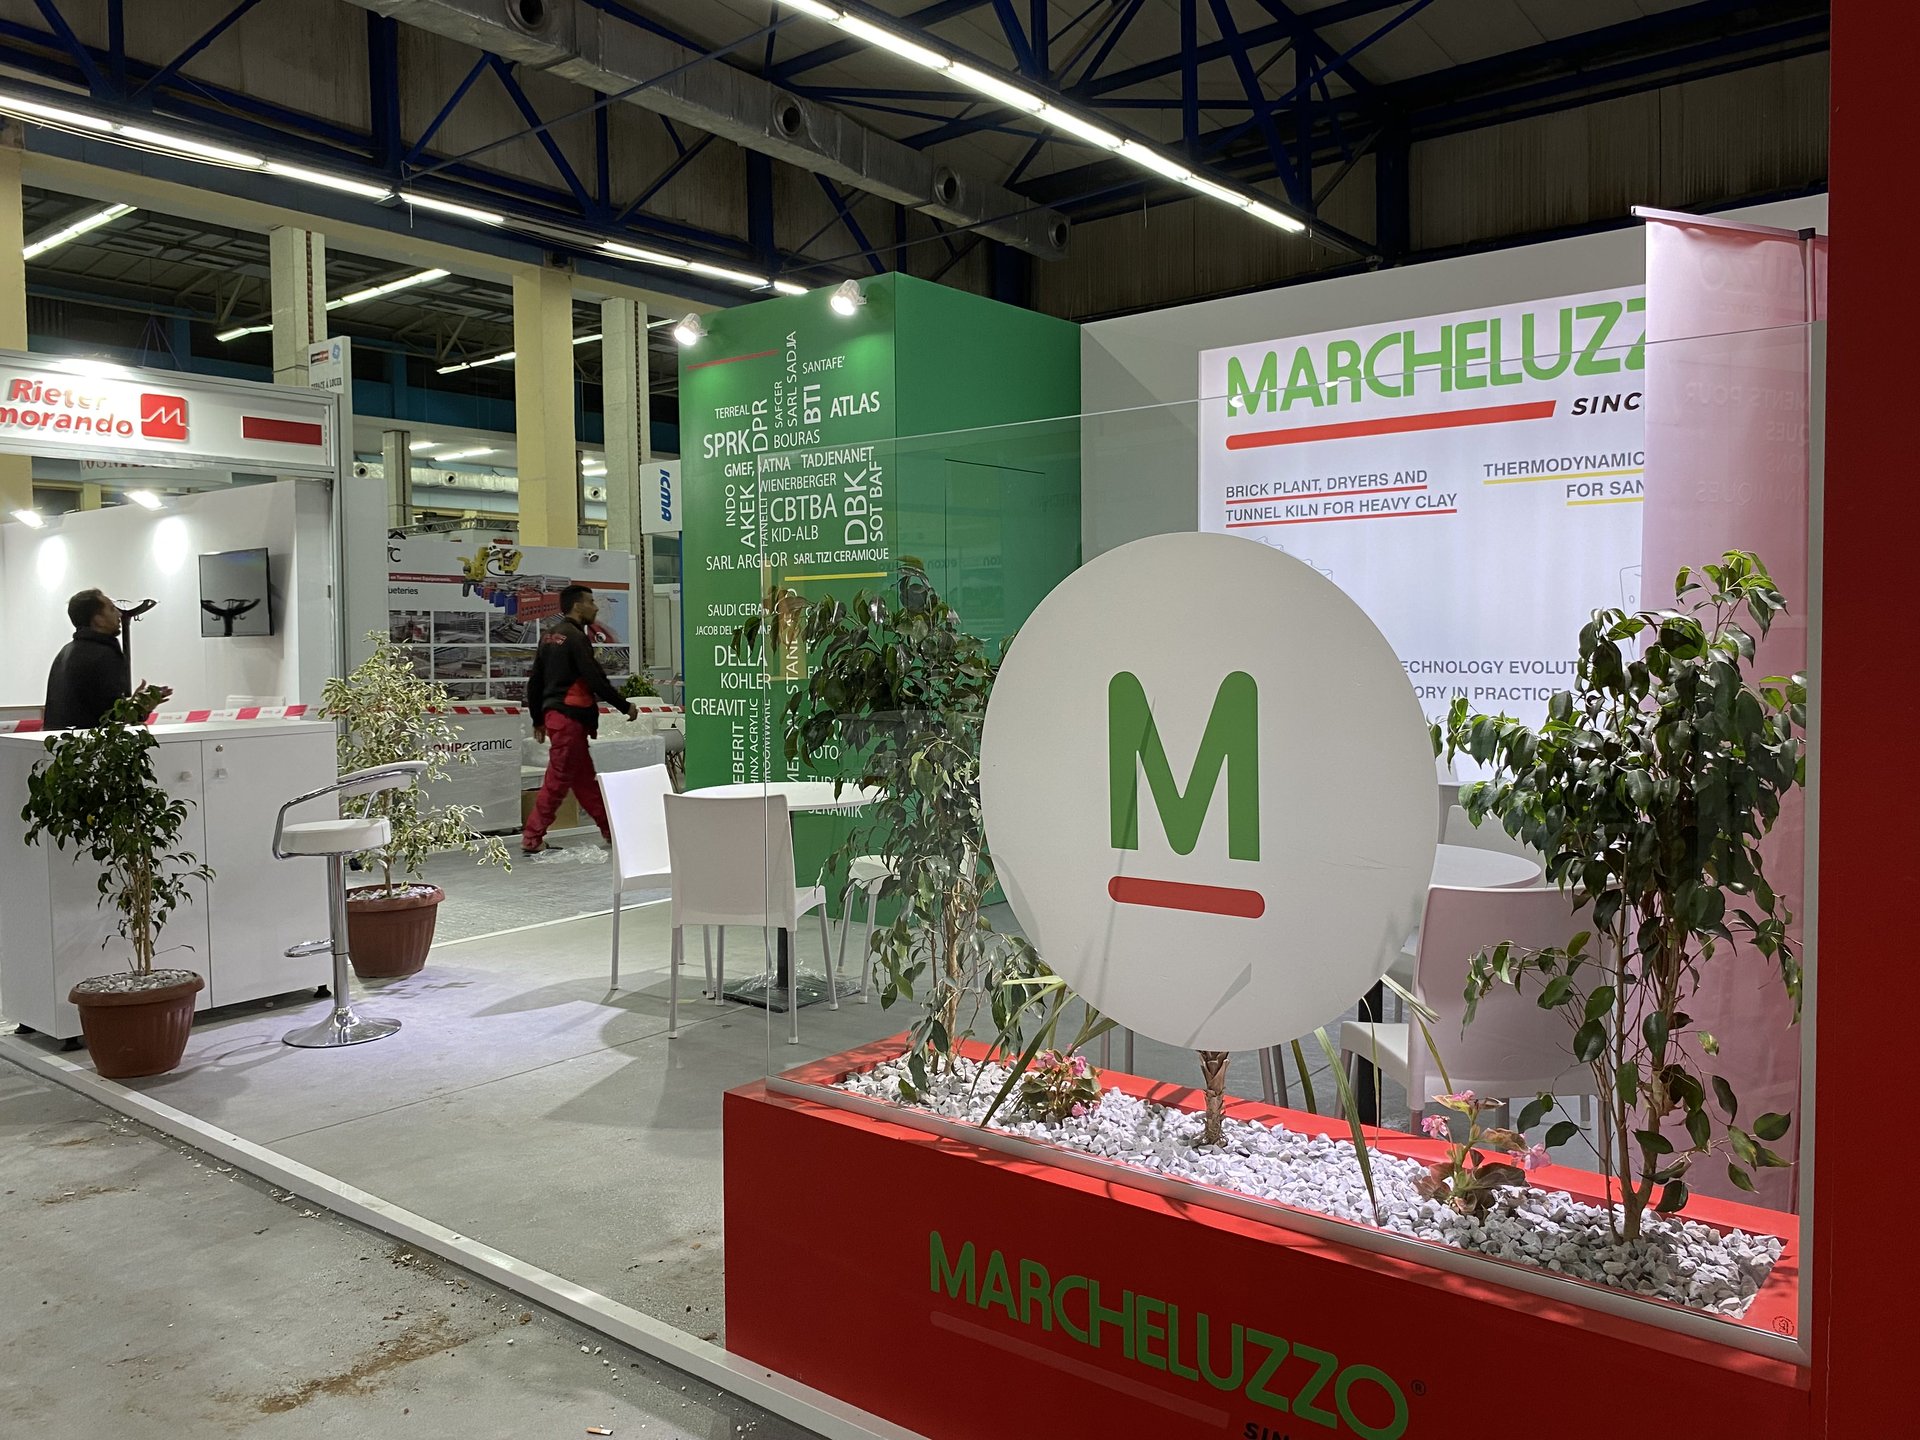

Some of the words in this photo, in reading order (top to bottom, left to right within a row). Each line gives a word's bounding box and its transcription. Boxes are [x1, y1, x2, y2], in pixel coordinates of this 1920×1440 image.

[714, 404, 750, 419] TERREAL
[774, 380, 783, 428] SAFCER
[787, 386, 798, 427] SARL
[803, 384, 821, 424] BTI
[830, 391, 880, 418] ATLAS
[0, 407, 134, 437] morando
[752, 398, 768, 452] DPR
[703, 428, 751, 459] SPRK
[774, 429, 820, 449] BOURAS
[801, 446, 875, 469] TADJENANET
[1484, 451, 1645, 478] THERMODYNAMIC
[759, 472, 837, 493] WIENERBERGER
[868, 461, 883, 499] BAF
[1226, 483, 1269, 499] BRICK
[1273, 479, 1321, 496] PLANT,
[1326, 473, 1389, 490] DRYERS
[1393, 470, 1428, 486] AND
[1566, 484, 1600, 499] FOR
[660, 469, 672, 522] ICMA
[725, 484, 736, 527] INDO
[770, 493, 838, 523] CBTBA
[843, 468, 868, 545] DBK
[1226, 507, 1281, 522] TUNNEL
[1286, 503, 1318, 518] KILN
[1323, 500, 1354, 515] FOR
[1359, 497, 1412, 512] HEAVY
[1415, 493, 1457, 509] CLAY
[740, 483, 756, 548] AKEK
[869, 503, 884, 542] SOT
[771, 525, 819, 542] KID-ALB
[706, 555, 734, 571] SARL
[793, 552, 816, 565] SARL
[815, 551, 832, 564] TIZI
[833, 547, 889, 563] CERAMIQUE
[707, 603, 737, 617] SAUDI
[695, 625, 718, 636] JACOB
[714, 645, 768, 668] DELLA
[720, 672, 771, 690] KOHLER
[1452, 687, 1468, 699] IN
[692, 698, 746, 717] CREAVIT
[749, 698, 759, 753] ACRYLIC
[1108, 671, 1260, 862] M
[930, 1231, 1409, 1440] MARCHELUZZO
